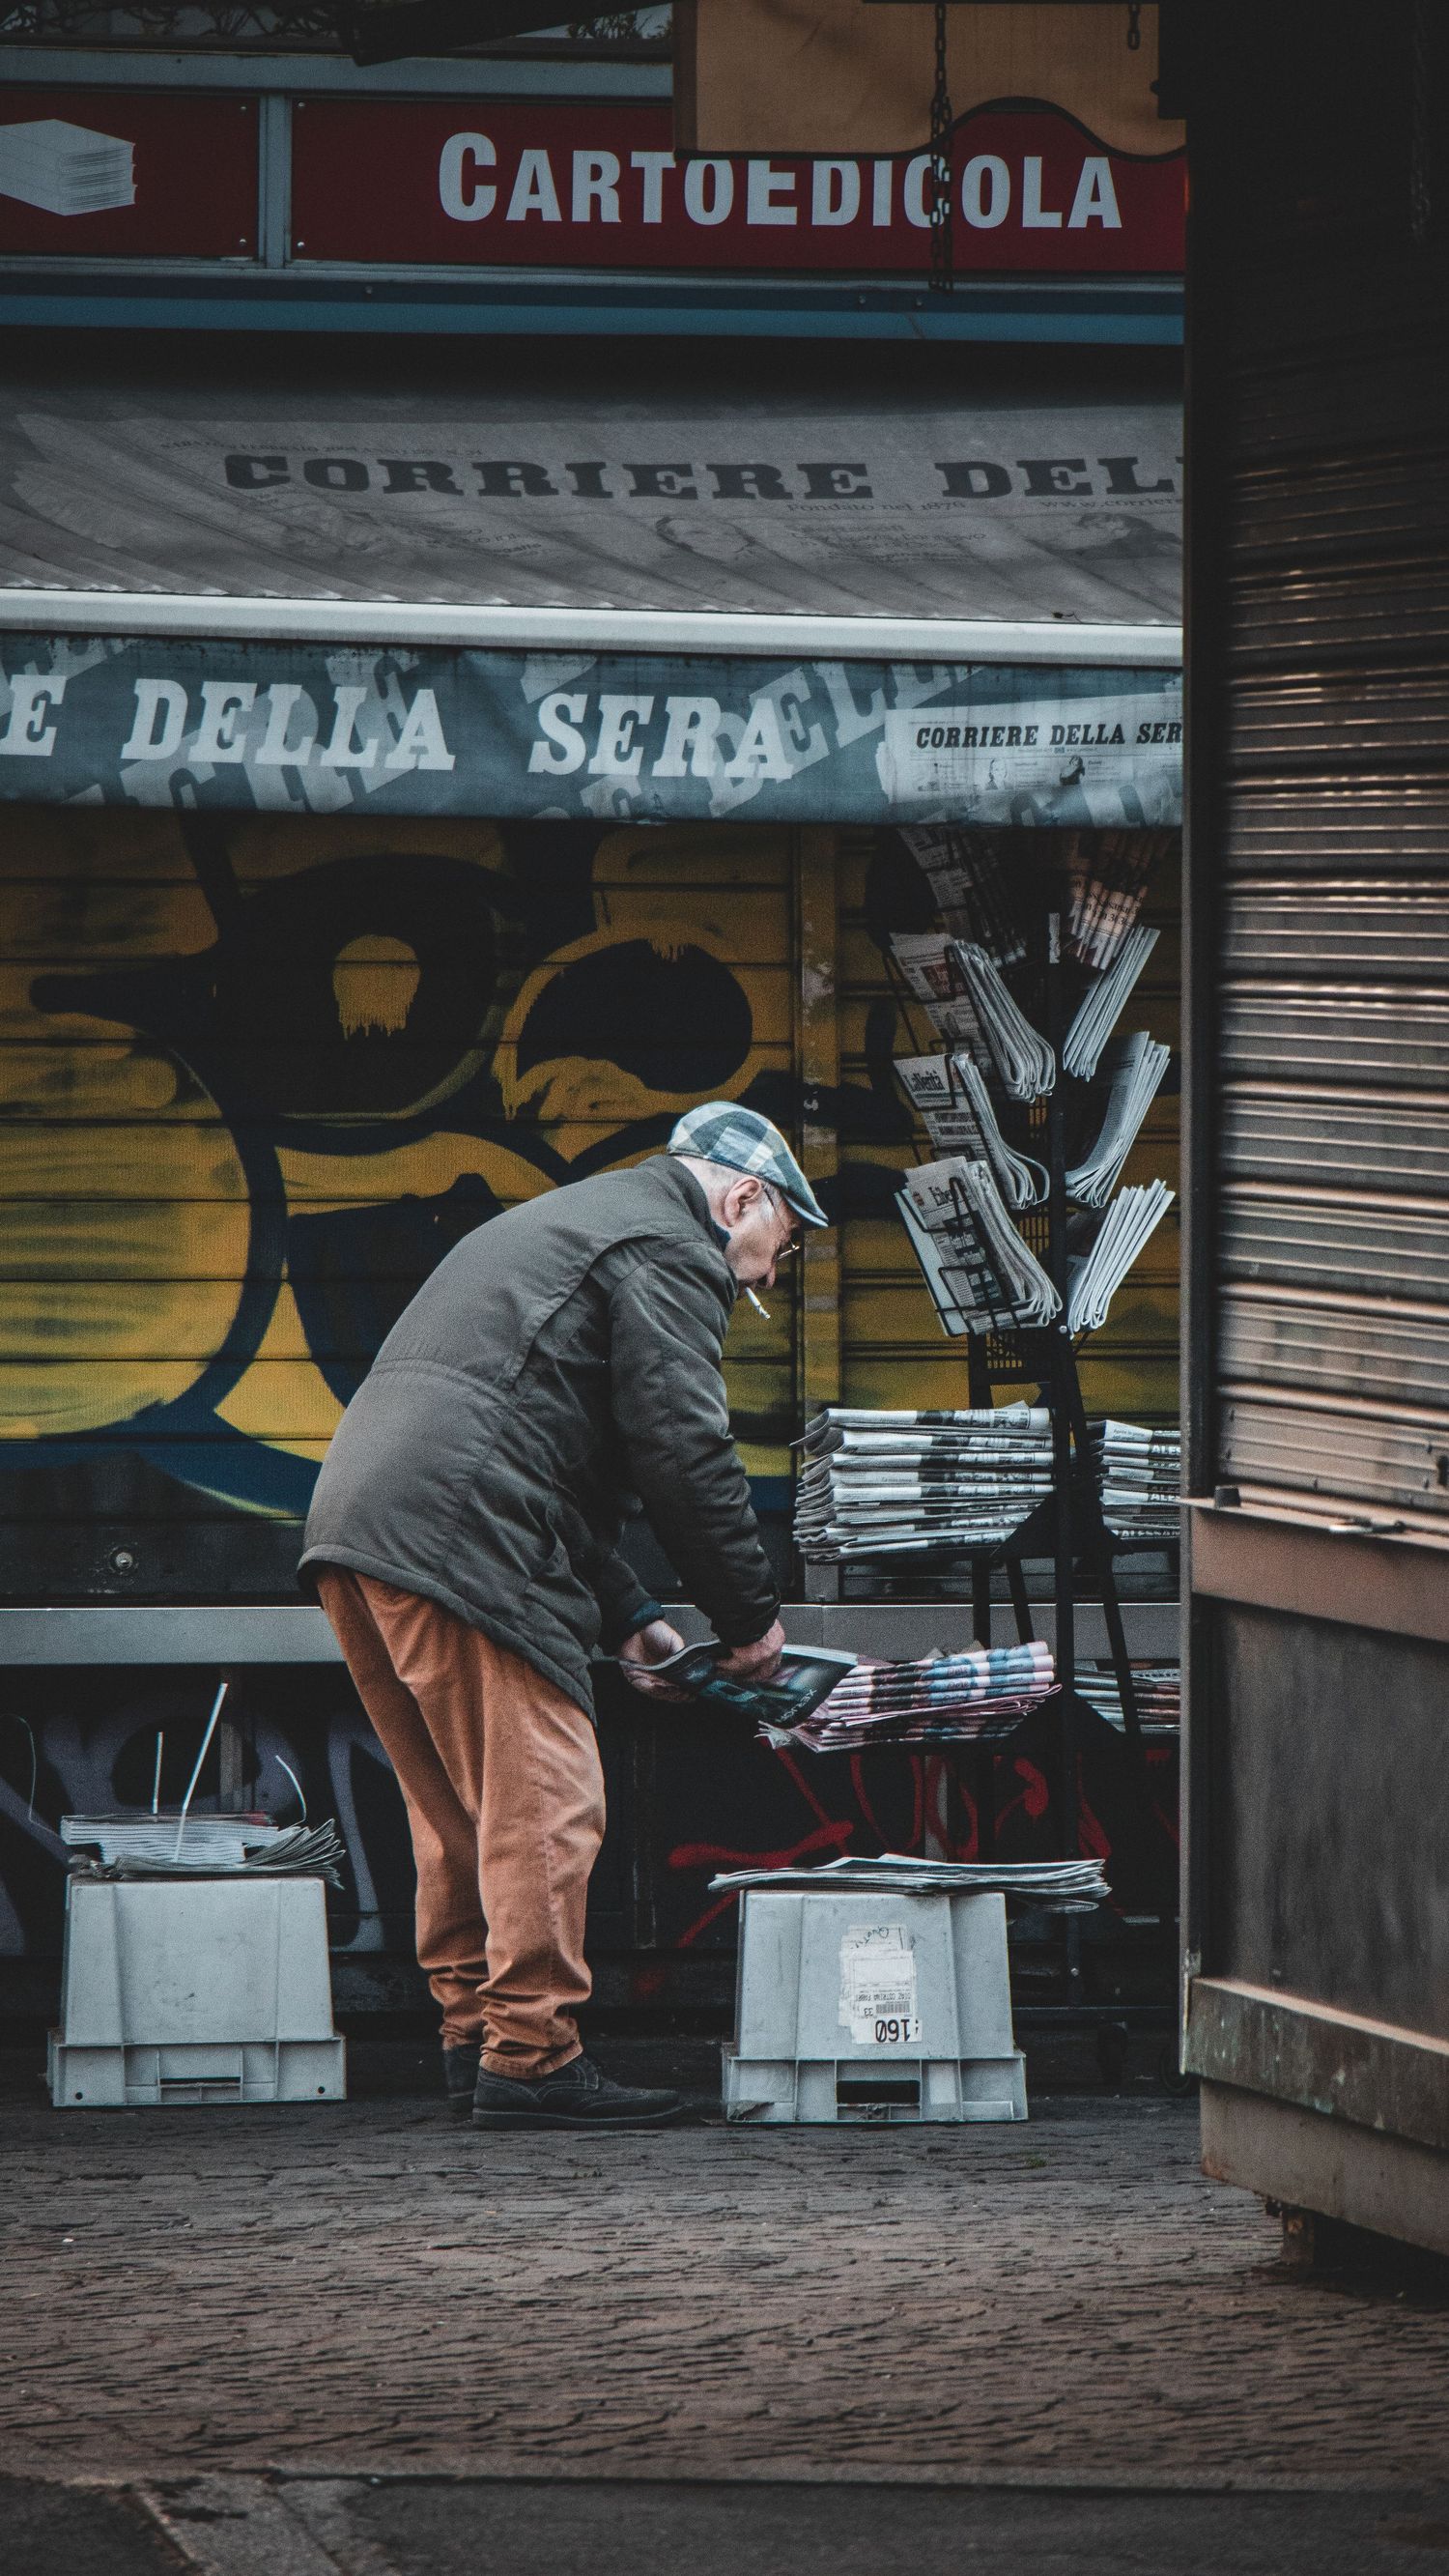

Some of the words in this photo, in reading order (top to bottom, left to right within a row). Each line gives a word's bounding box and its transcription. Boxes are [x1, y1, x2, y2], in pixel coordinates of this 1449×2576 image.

[439, 131, 1122, 229] CARTOEDICOLA
[225, 453, 874, 501] CORRIERE
[934, 455, 1184, 500] DEL
[786, 501, 875, 513] Fondato
[881, 501, 913, 513] nel
[120, 677, 456, 771] DELLA
[527, 693, 793, 781] SERA
[916, 724, 1039, 750] CORRIERE
[1049, 723, 1125, 746] DELLA
[875, 2018, 911, 2043] 160
